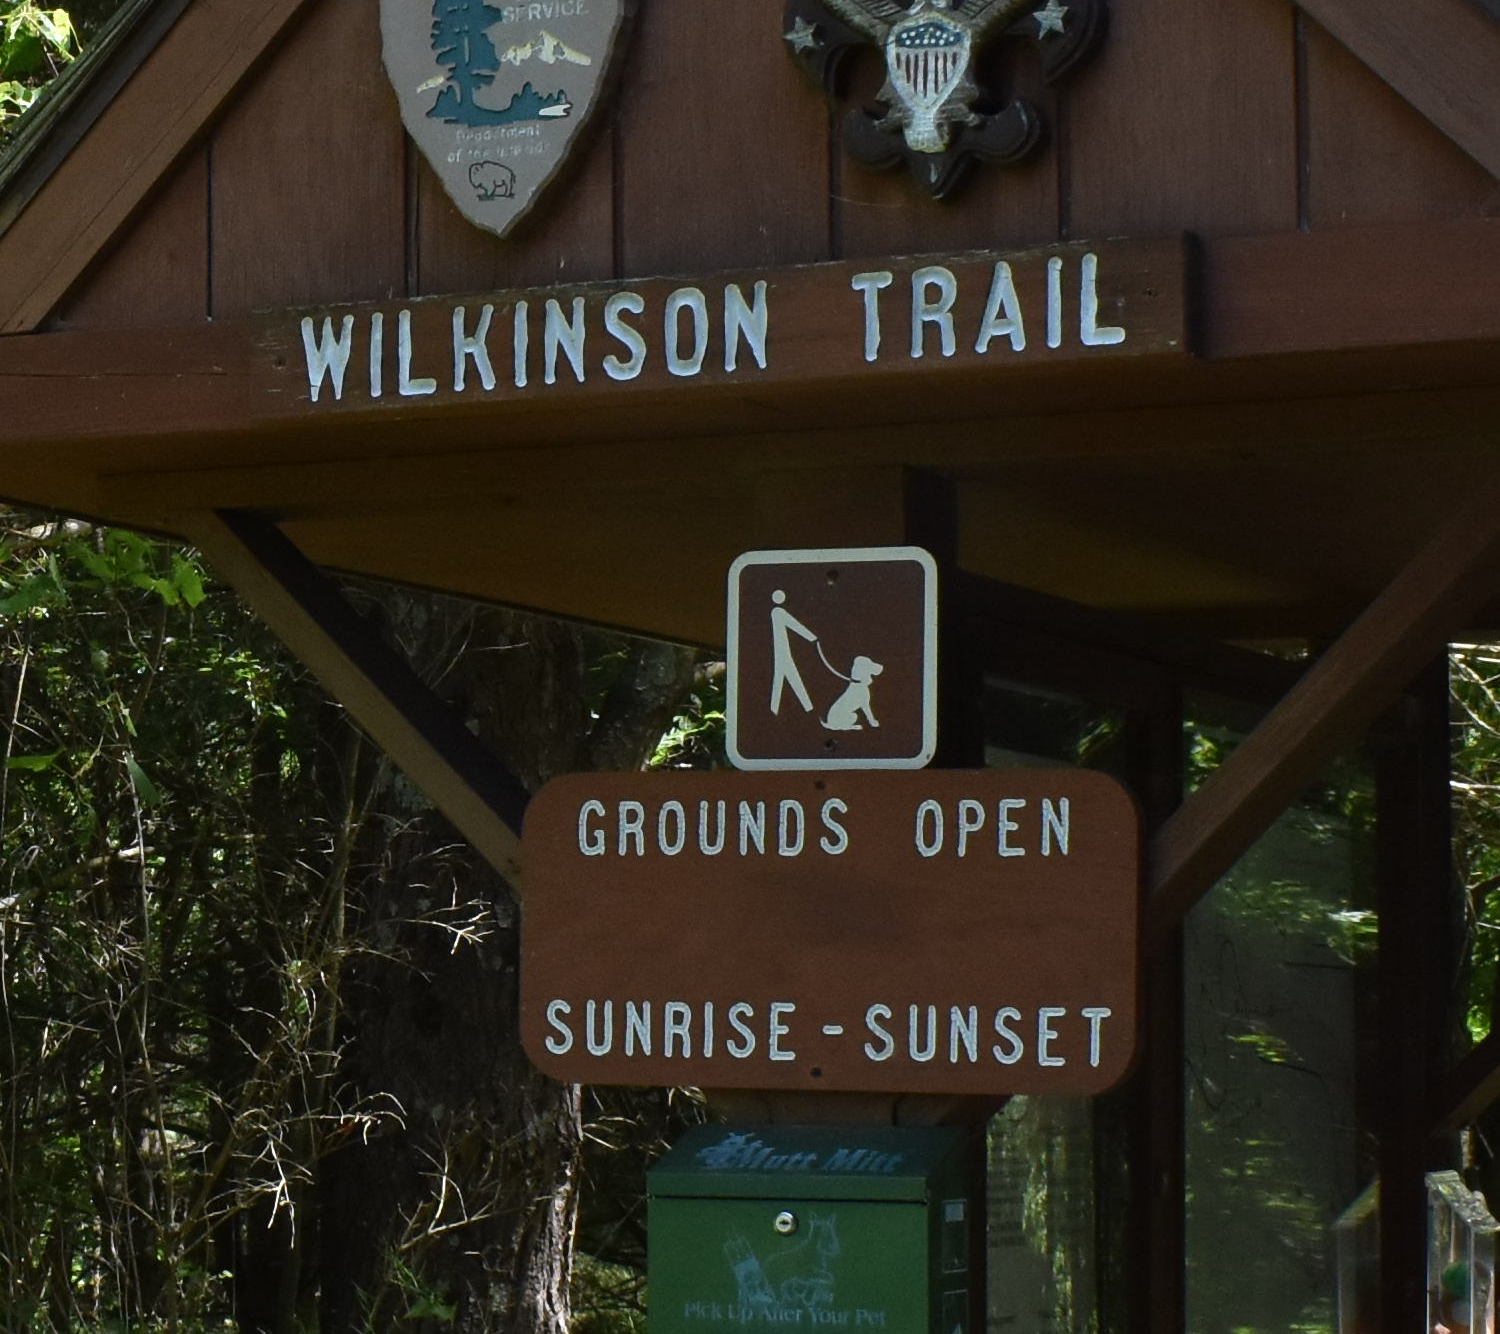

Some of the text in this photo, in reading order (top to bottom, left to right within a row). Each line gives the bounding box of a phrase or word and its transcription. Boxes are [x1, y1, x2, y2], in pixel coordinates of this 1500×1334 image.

[456, 124, 540, 141] Depatment
[447, 148, 464, 163] of
[300, 252, 1126, 402] WILKINSON TRAIL
[577, 797, 1071, 858] GROUNDS OPEN
[544, 999, 797, 1062] SUNRISE
[863, 1003, 1112, 1067] SUNSET
[821, 1147, 903, 1172] Mitt
[683, 1301, 887, 1326] Pick Up After Your Pet
